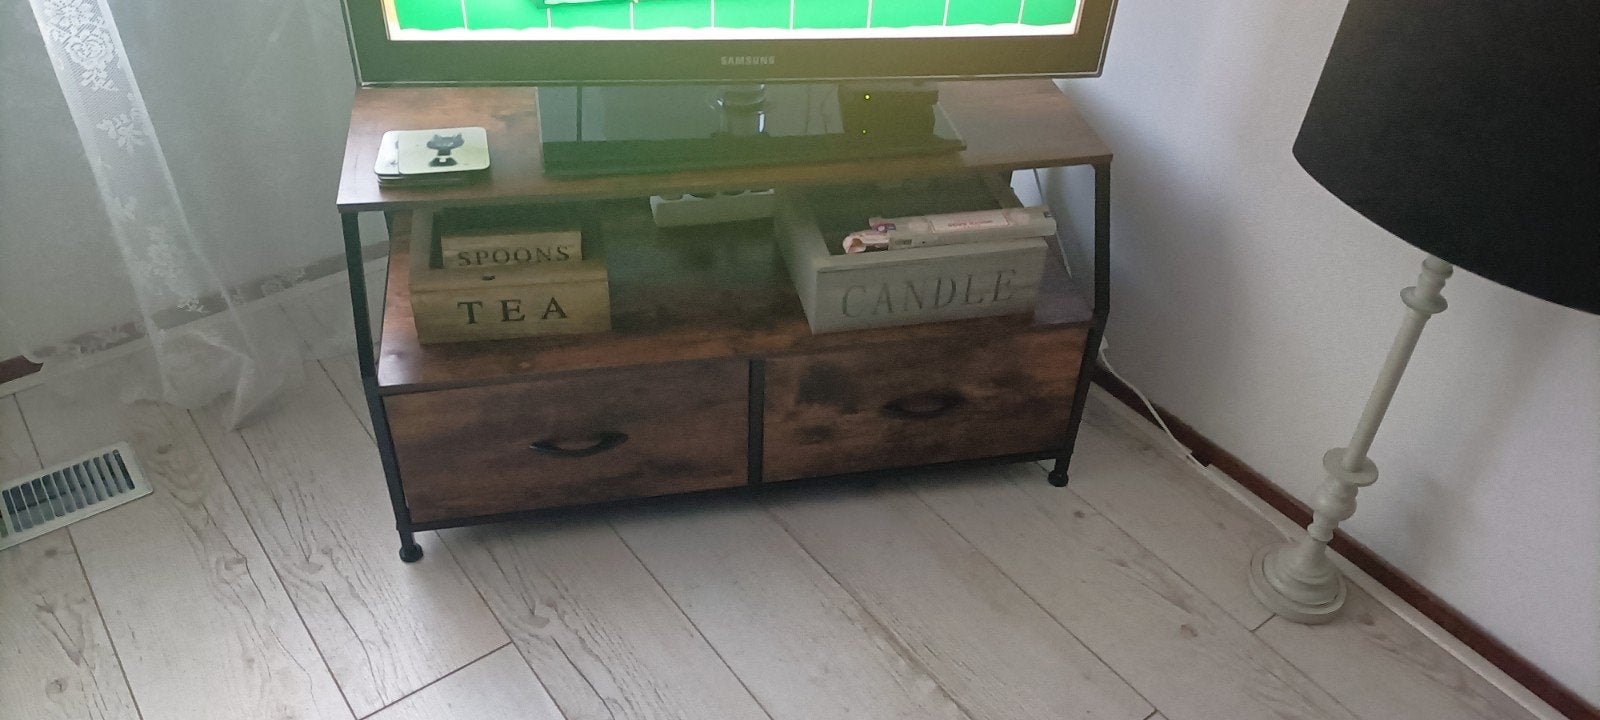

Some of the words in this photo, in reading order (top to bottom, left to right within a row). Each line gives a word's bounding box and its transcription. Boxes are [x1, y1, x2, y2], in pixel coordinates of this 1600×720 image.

[720, 55, 776, 65] SAMSUNG
[457, 245, 571, 267] SPOONS
[841, 268, 1016, 318] CANDLE
[456, 296, 568, 325] TEA
